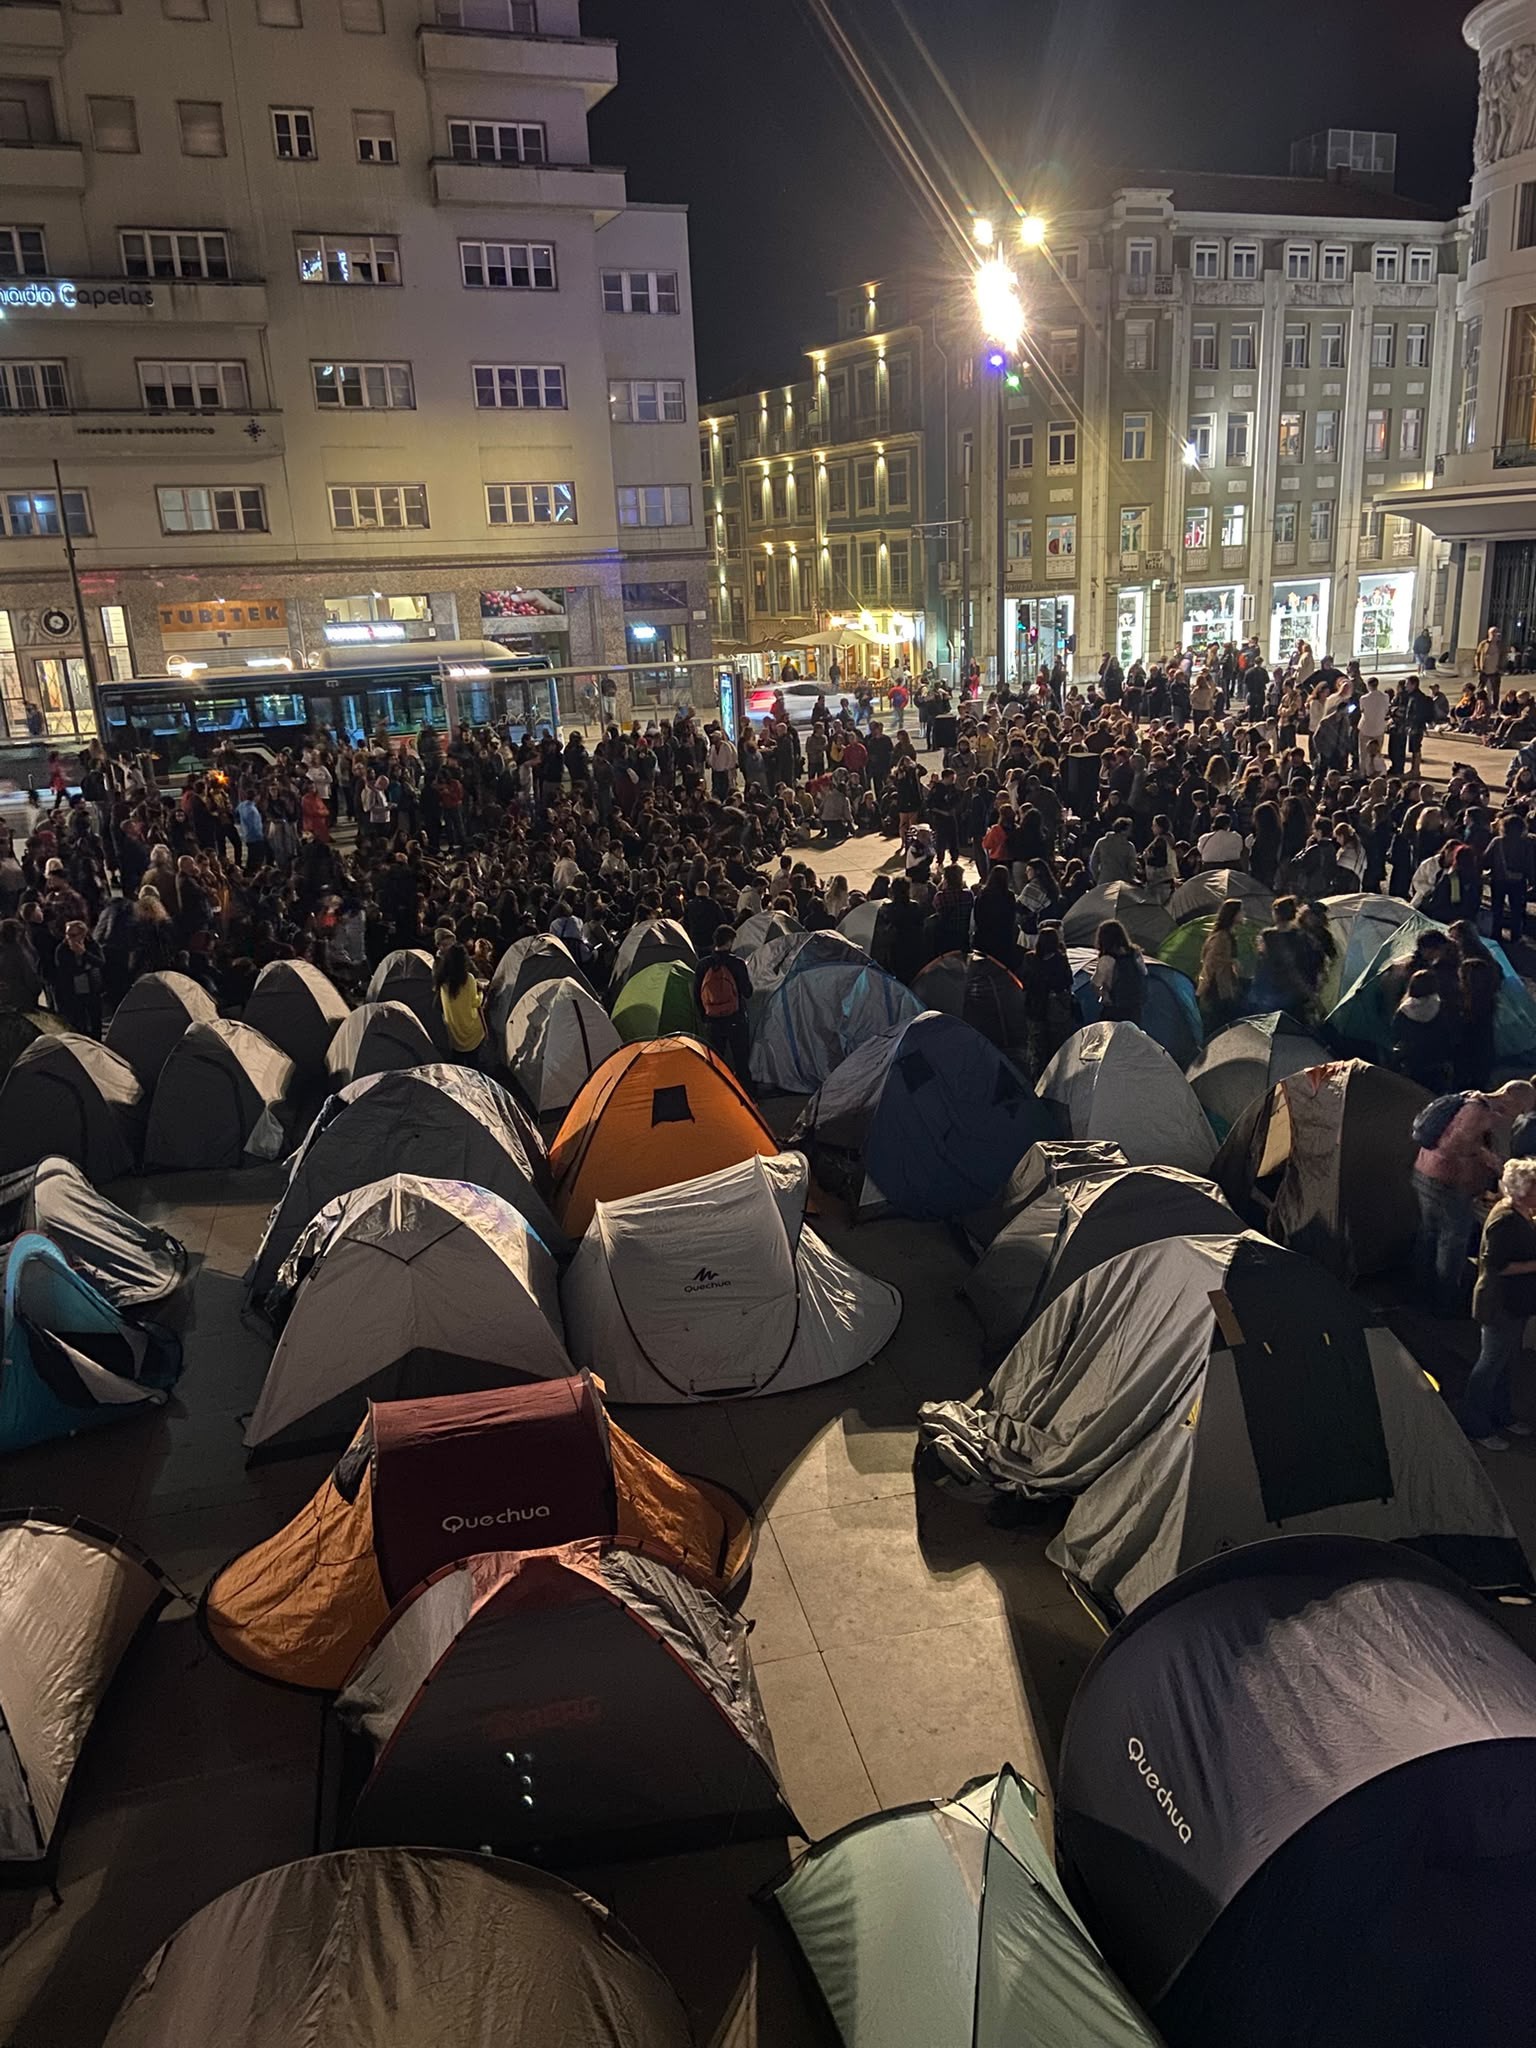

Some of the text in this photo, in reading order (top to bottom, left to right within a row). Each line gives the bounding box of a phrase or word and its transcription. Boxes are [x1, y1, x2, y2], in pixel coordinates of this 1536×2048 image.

[60, 283, 154, 308] Capelas
[159, 606, 279, 625] TUBITEK
[684, 1280, 731, 1293] Quechua
[442, 1505, 550, 1534] Quechua
[1128, 1737, 1192, 1845] Quechua
